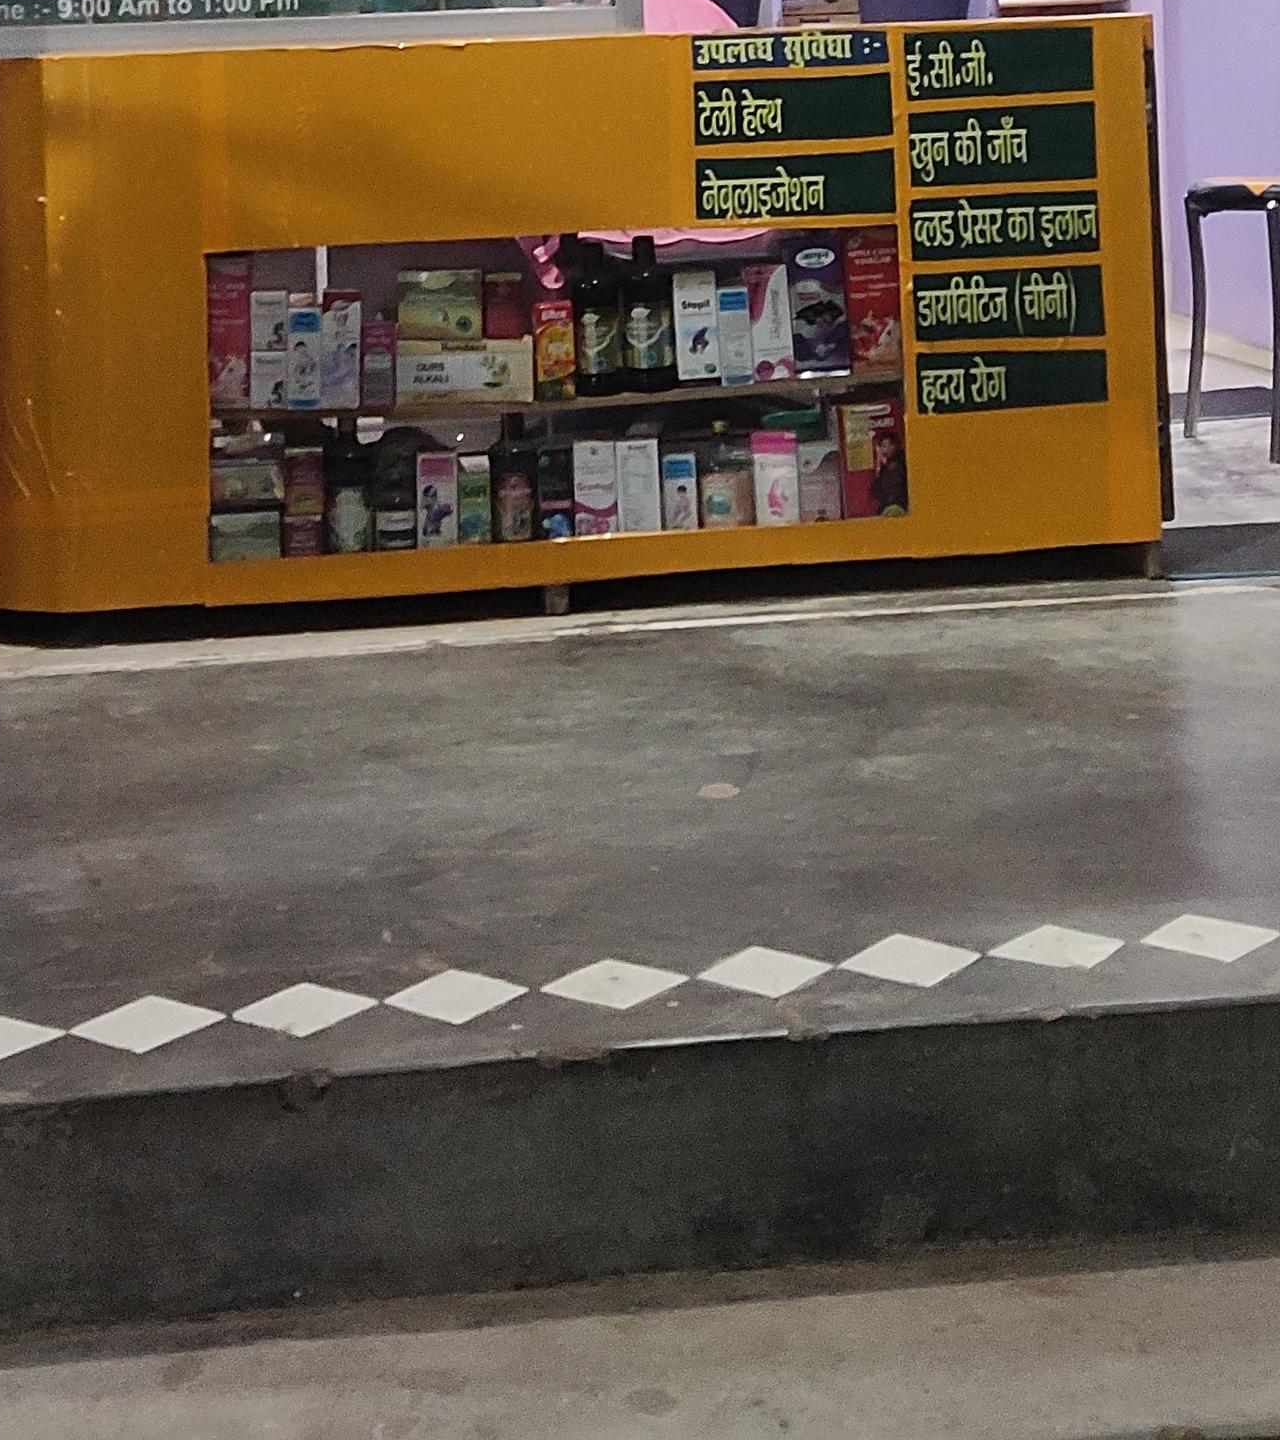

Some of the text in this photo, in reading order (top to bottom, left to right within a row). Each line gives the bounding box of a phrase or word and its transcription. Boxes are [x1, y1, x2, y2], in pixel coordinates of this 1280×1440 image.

[697, 87, 738, 136] टेली
[909, 131, 950, 183] खुन
[953, 117, 982, 165] की
[957, 199, 1004, 249] प्रेसर
[1006, 206, 1036, 242] का
[1038, 204, 1097, 248] इलाज
[969, 356, 1007, 403] रोग
